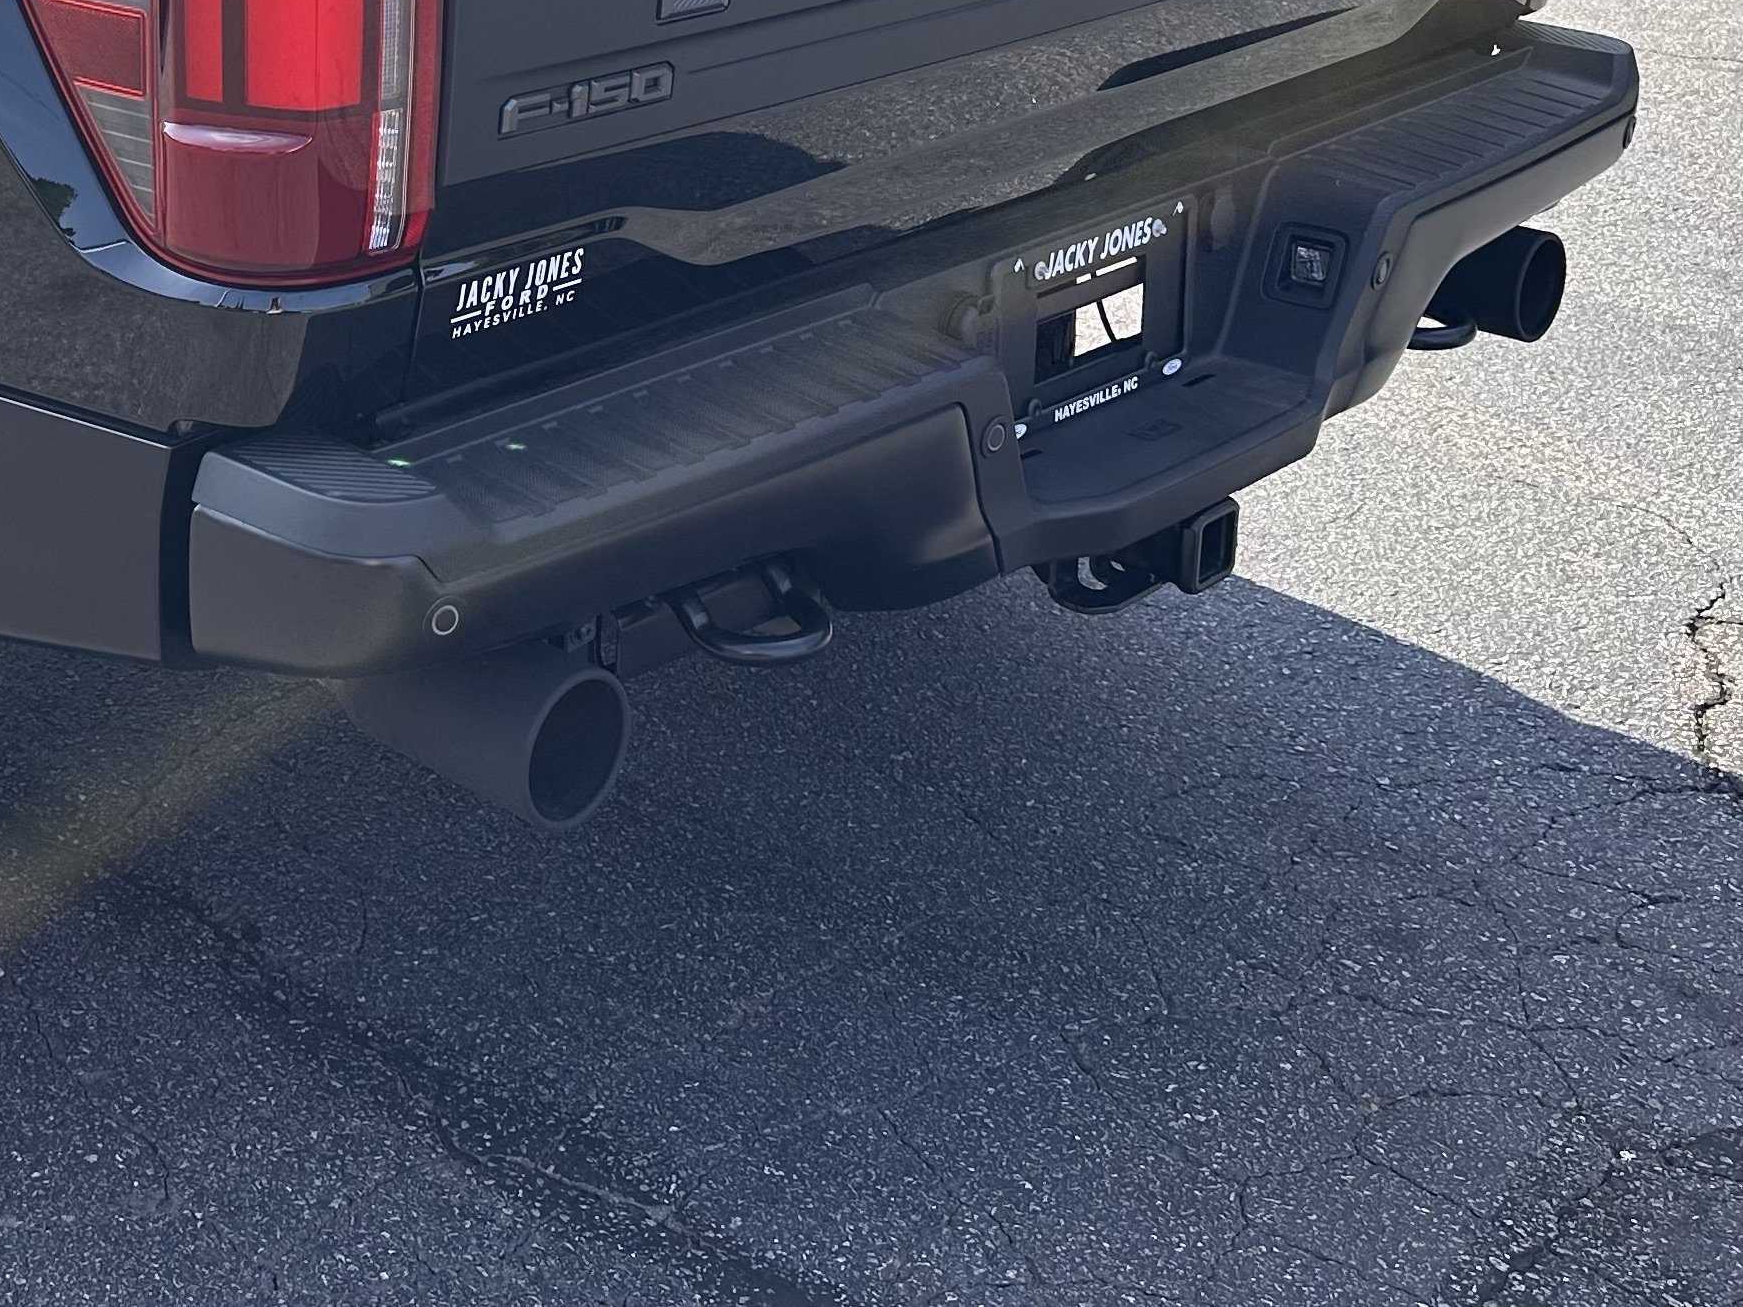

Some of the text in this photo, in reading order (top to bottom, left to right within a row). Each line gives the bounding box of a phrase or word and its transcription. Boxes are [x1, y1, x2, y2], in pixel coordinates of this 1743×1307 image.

[498, 61, 675, 137] F-150
[1044, 217, 1153, 280] JACKY JONES
[456, 248, 584, 312] JACKY JONES
[484, 284, 549, 317] FORD
[555, 290, 576, 306] NC
[1054, 376, 1139, 423] HAYESVILLE, NC
